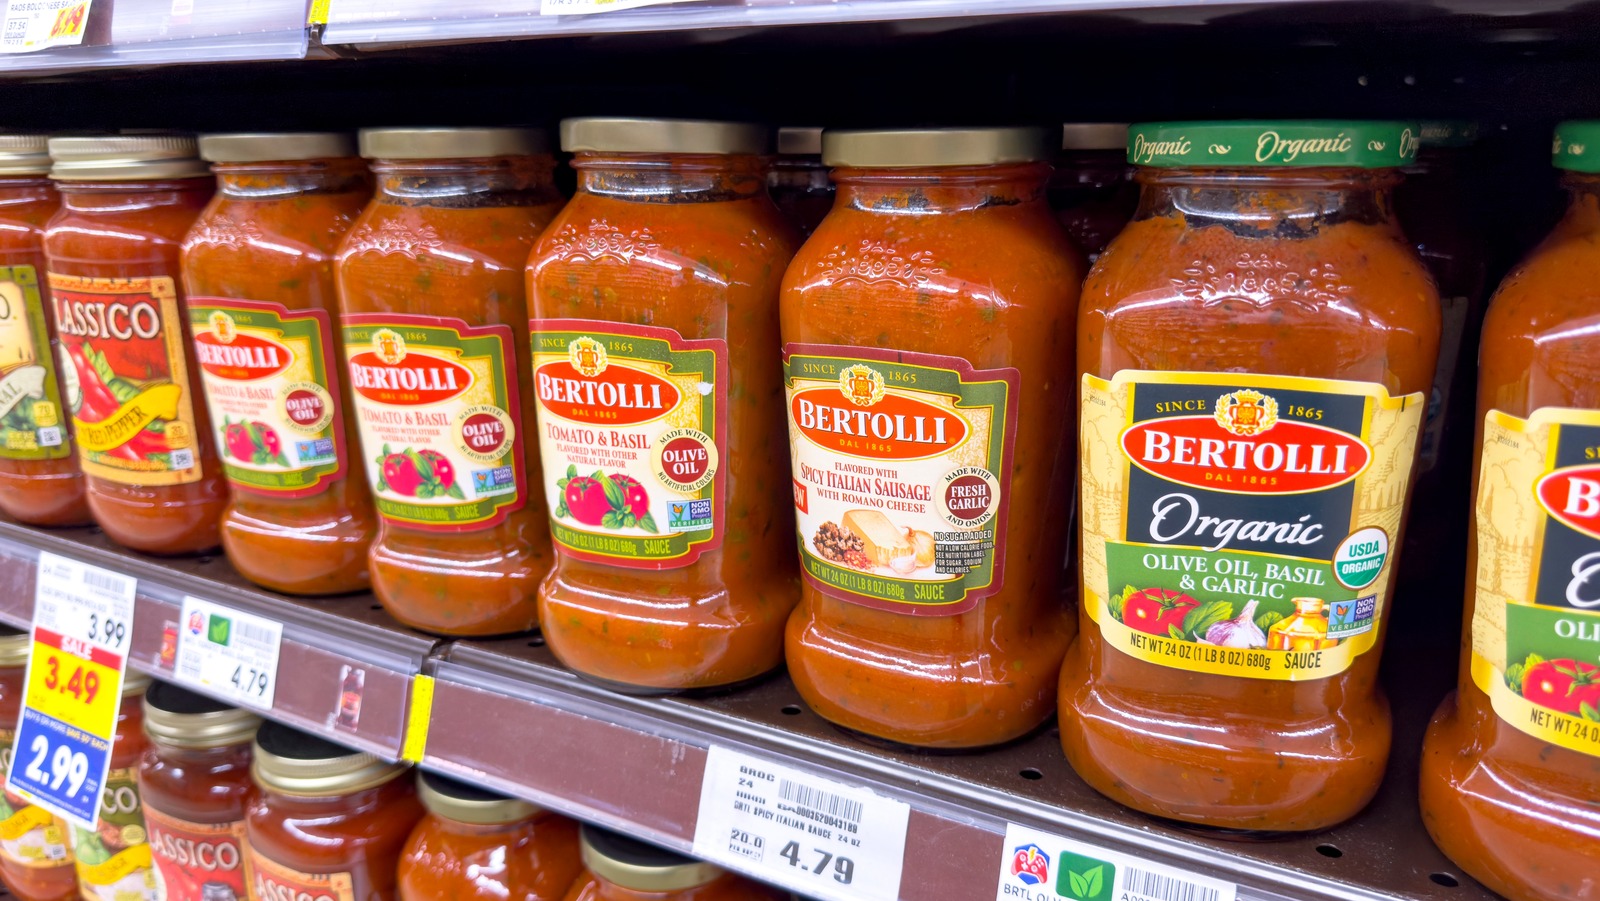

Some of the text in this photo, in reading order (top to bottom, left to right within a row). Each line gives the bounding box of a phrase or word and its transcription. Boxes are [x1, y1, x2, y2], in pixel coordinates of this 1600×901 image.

[1134, 134, 1191, 163] Organic
[1255, 131, 1351, 162] Organic
[52, 297, 160, 340] LASSICO
[540, 338, 634, 352] SINCE 1865
[198, 344, 280, 368] BERTOLLI
[352, 361, 458, 391] BERTOLLI
[803, 362, 917, 384] SINCE 1865
[538, 372, 663, 410] BERTOLLI
[293, 409, 318, 420] OIL
[362, 406, 452, 426] TOMATO & BASIL
[460, 406, 502, 420] MADE WITH
[572, 408, 617, 419] DAL 1865
[1156, 400, 1324, 420] SINCE 1865
[462, 420, 504, 437] OLIVE
[799, 398, 948, 445] BERTOLLI
[472, 434, 498, 447] OIL
[546, 422, 652, 450] TOMATO & BASIL
[659, 429, 708, 445] MADE WITH
[840, 439, 892, 452] DAL 1865
[556, 444, 638, 460] FLAVORED WITH OTHER
[566, 454, 626, 469] NATURAL FLAVOR
[662, 448, 707, 463] OLIVE
[1142, 429, 1348, 474] BERTOLLI
[672, 461, 699, 475] OIL
[834, 462, 898, 479] FLAVORED WITH
[944, 467, 992, 483] MADE WITH
[658, 468, 715, 492] NO ARTIFICIAL COLORS
[800, 462, 932, 501] SPICY ITALIAN SAUSAGE
[1206, 472, 1278, 486] DAL 1865
[816, 487, 926, 514] WITH ROMANO CHEESE
[950, 484, 986, 498] FRESH
[454, 504, 479, 519] SAUCE
[691, 506, 710, 514] GMO
[948, 496, 990, 510] GARLIC
[671, 519, 711, 527] VERIFIED
[946, 511, 992, 527] AND ONION
[1149, 492, 1324, 552] Organic
[573, 533, 580, 542] 24
[580, 535, 588, 546] OZ
[596, 538, 604, 550] LB
[604, 539, 609, 550] 8
[621, 540, 637, 556] 680g
[644, 540, 671, 554] SAUCE
[934, 530, 992, 541] NO SUGAR ADDED
[970, 550, 986, 558] LABEL
[1348, 540, 1380, 558] USDA
[1142, 553, 1326, 586] OLIVE OIL, BASIL
[1341, 556, 1382, 575] ORGANIC
[810, 562, 945, 600] NET WT 24 OZ (1 LB 8 OZ) 680g SAUCE
[1179, 574, 1286, 599] & GARLIC
[1356, 604, 1374, 615] GMO
[1357, 597, 1375, 608] NON
[88, 613, 125, 648] 3.99
[1330, 618, 1371, 631] VERIFIED
[1554, 619, 1600, 642] OLI
[60, 636, 93, 660] SALE
[1130, 632, 1323, 671] NET WT 24 OZ (1 LB 8 OZ) 680g SAUCE
[44, 655, 100, 704] 3.49
[231, 664, 268, 696] 4.79
[1530, 708, 1588, 740] NET WT 24
[25, 734, 89, 798] 2.99
[738, 778, 754, 788] 24
[754, 806, 861, 848] SPICY ITALIAN SAUCE 24 OZ
[153, 829, 240, 871] ASSICO
[780, 840, 855, 884] 4.79
[1004, 883, 1032, 901] BRTL
